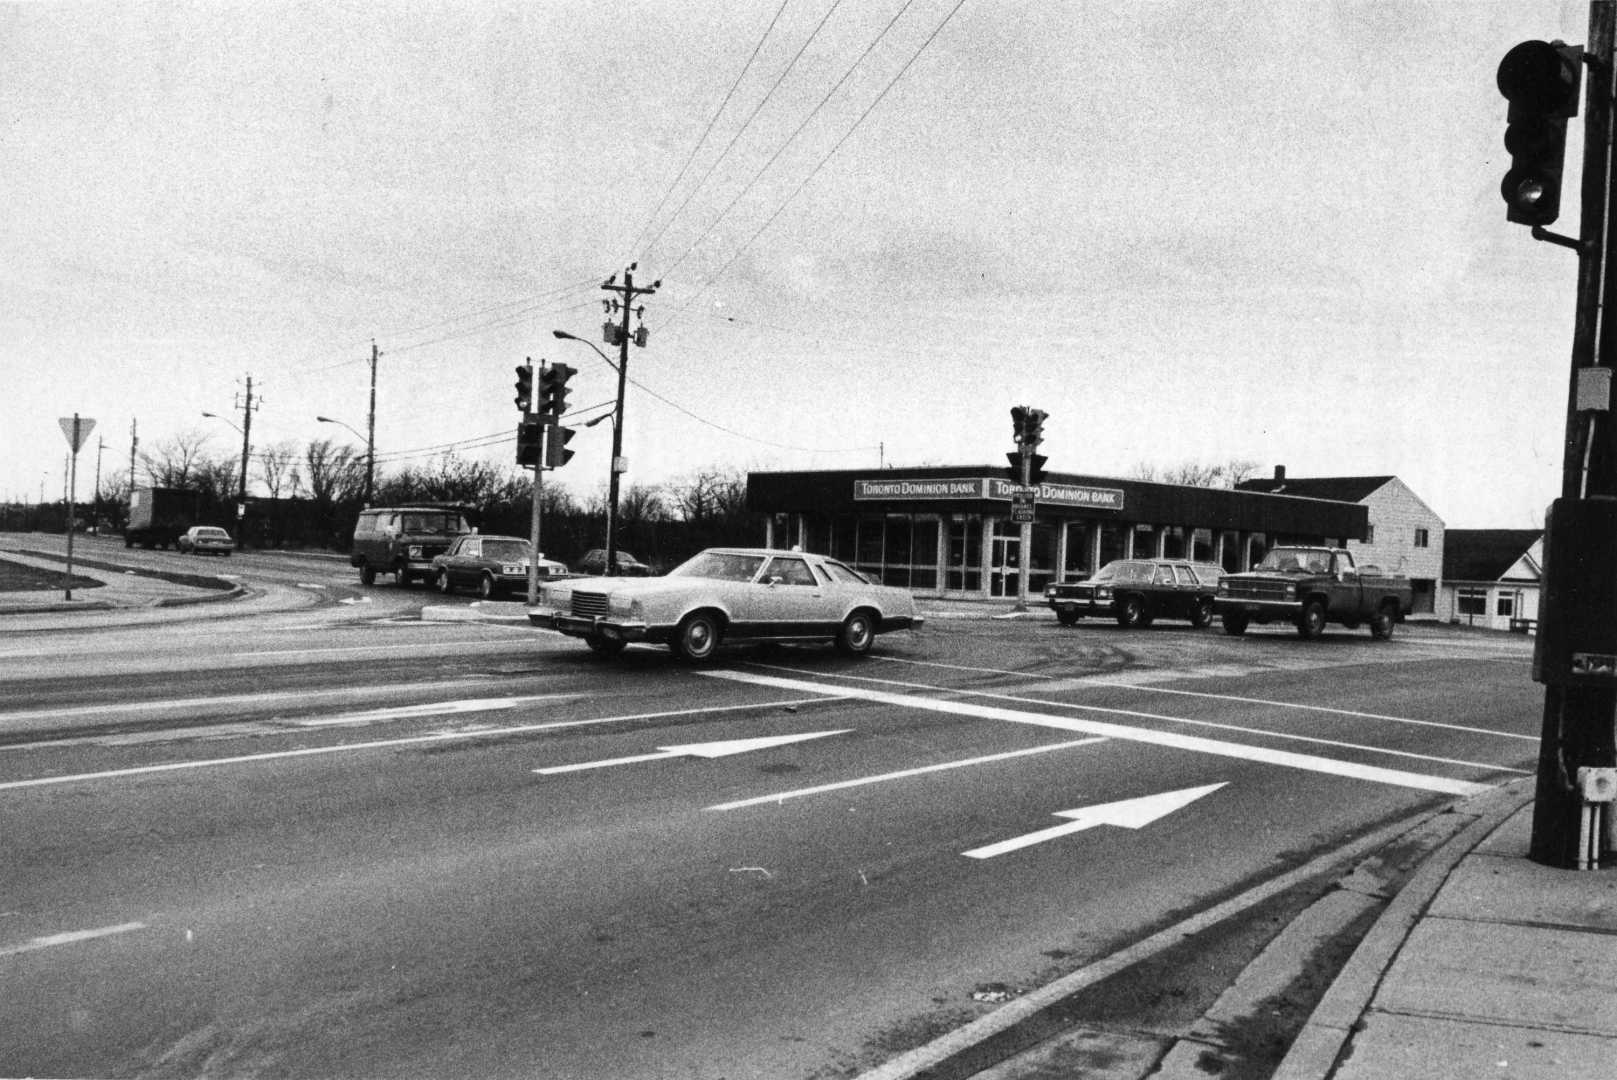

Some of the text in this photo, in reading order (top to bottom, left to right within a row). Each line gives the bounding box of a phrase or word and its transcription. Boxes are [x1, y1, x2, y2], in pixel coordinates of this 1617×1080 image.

[861, 482, 976, 495] TORONTO DOMINION BANK
[1042, 485, 1090, 501] DOMINION
[1091, 491, 1115, 503] BANK
